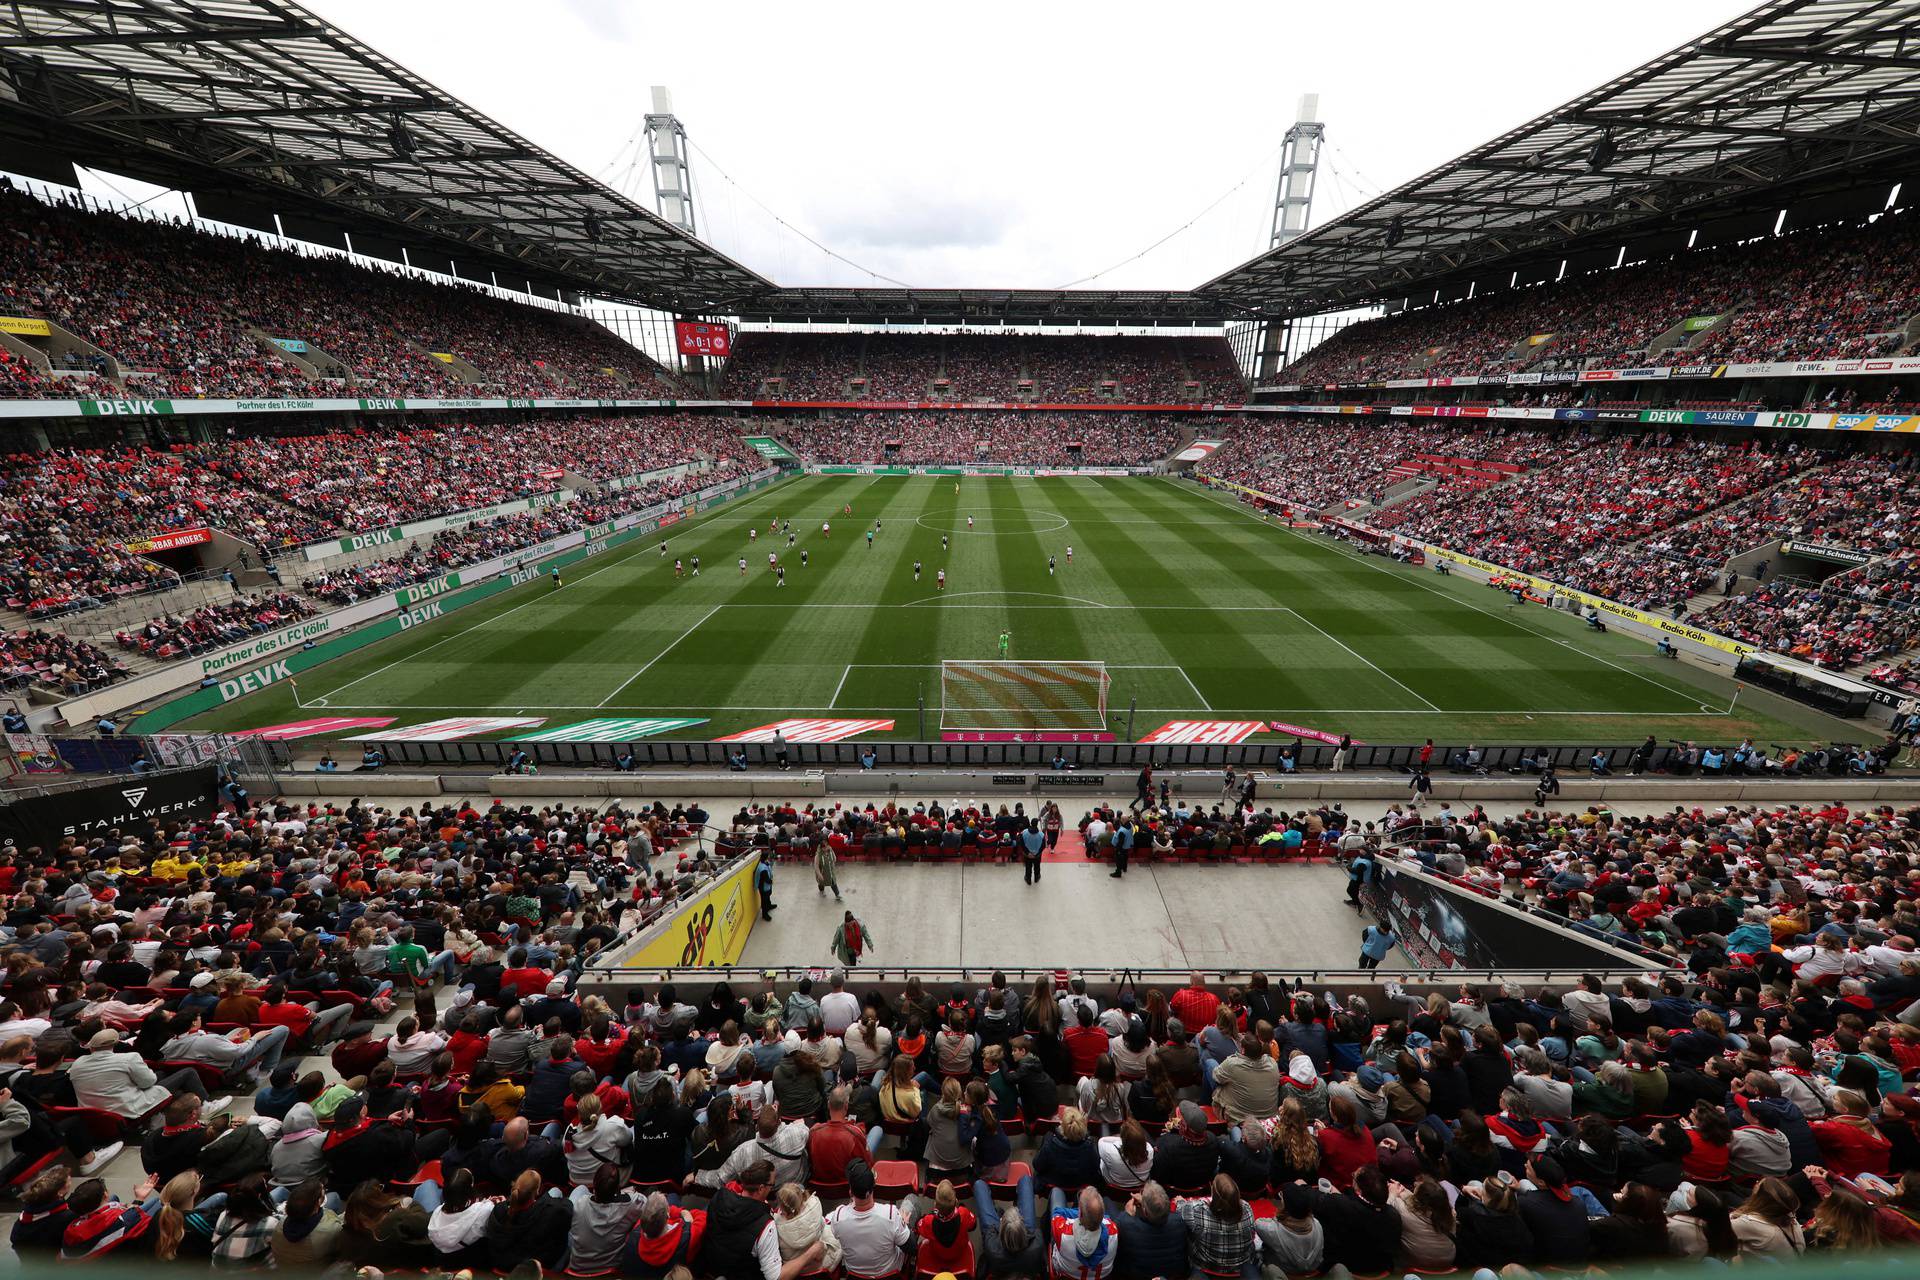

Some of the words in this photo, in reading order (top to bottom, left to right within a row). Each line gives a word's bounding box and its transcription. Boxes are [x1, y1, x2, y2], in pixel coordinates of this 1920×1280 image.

[18, 321, 46, 330] Airport
[1672, 366, 1712, 374] X-PRINT.DE
[1746, 365, 1771, 373] seitz
[1479, 376, 1507, 384] BAUWENS
[96, 400, 158, 415] DEVK
[237, 401, 265, 409] Partner
[267, 401, 280, 409] des
[287, 401, 296, 409] FC
[297, 401, 313, 409] Köln!
[367, 400, 398, 409] DEVK
[511, 400, 530, 408] DEVK
[1649, 411, 1685, 422] DEVK
[1705, 412, 1745, 421] SAUREN
[1771, 413, 1812, 427] HDI
[1835, 417, 1860, 427] SAP
[1875, 418, 1903, 428] SAP
[534, 494, 555, 507] DEVK
[445, 514, 466, 526] Partner
[589, 523, 611, 539] DEVK
[153, 540, 174, 550] RBAR
[175, 534, 206, 546] ANDERS.
[352, 529, 392, 550] DEVK
[586, 540, 607, 556] DEVK
[1793, 544, 1826, 555] Bäckerei
[1826, 550, 1868, 562] Schneider
[1481, 563, 1492, 571] Köln
[510, 565, 540, 586] DEVK
[407, 576, 451, 603] DEVK
[1566, 591, 1581, 601] Köln
[398, 602, 444, 630] DEVK
[1600, 601, 1620, 614] Radio
[1621, 608, 1638, 620] Köln
[1660, 621, 1685, 635] Radio
[1686, 630, 1706, 642] Köln
[203, 647, 253, 673] Partner
[255, 640, 277, 654] des
[287, 629, 301, 643] FC
[303, 619, 329, 637] Köln!
[218, 660, 293, 701] DEVK
[1278, 724, 1301, 734] MAGENTA
[1301, 729, 1318, 737] SPORT
